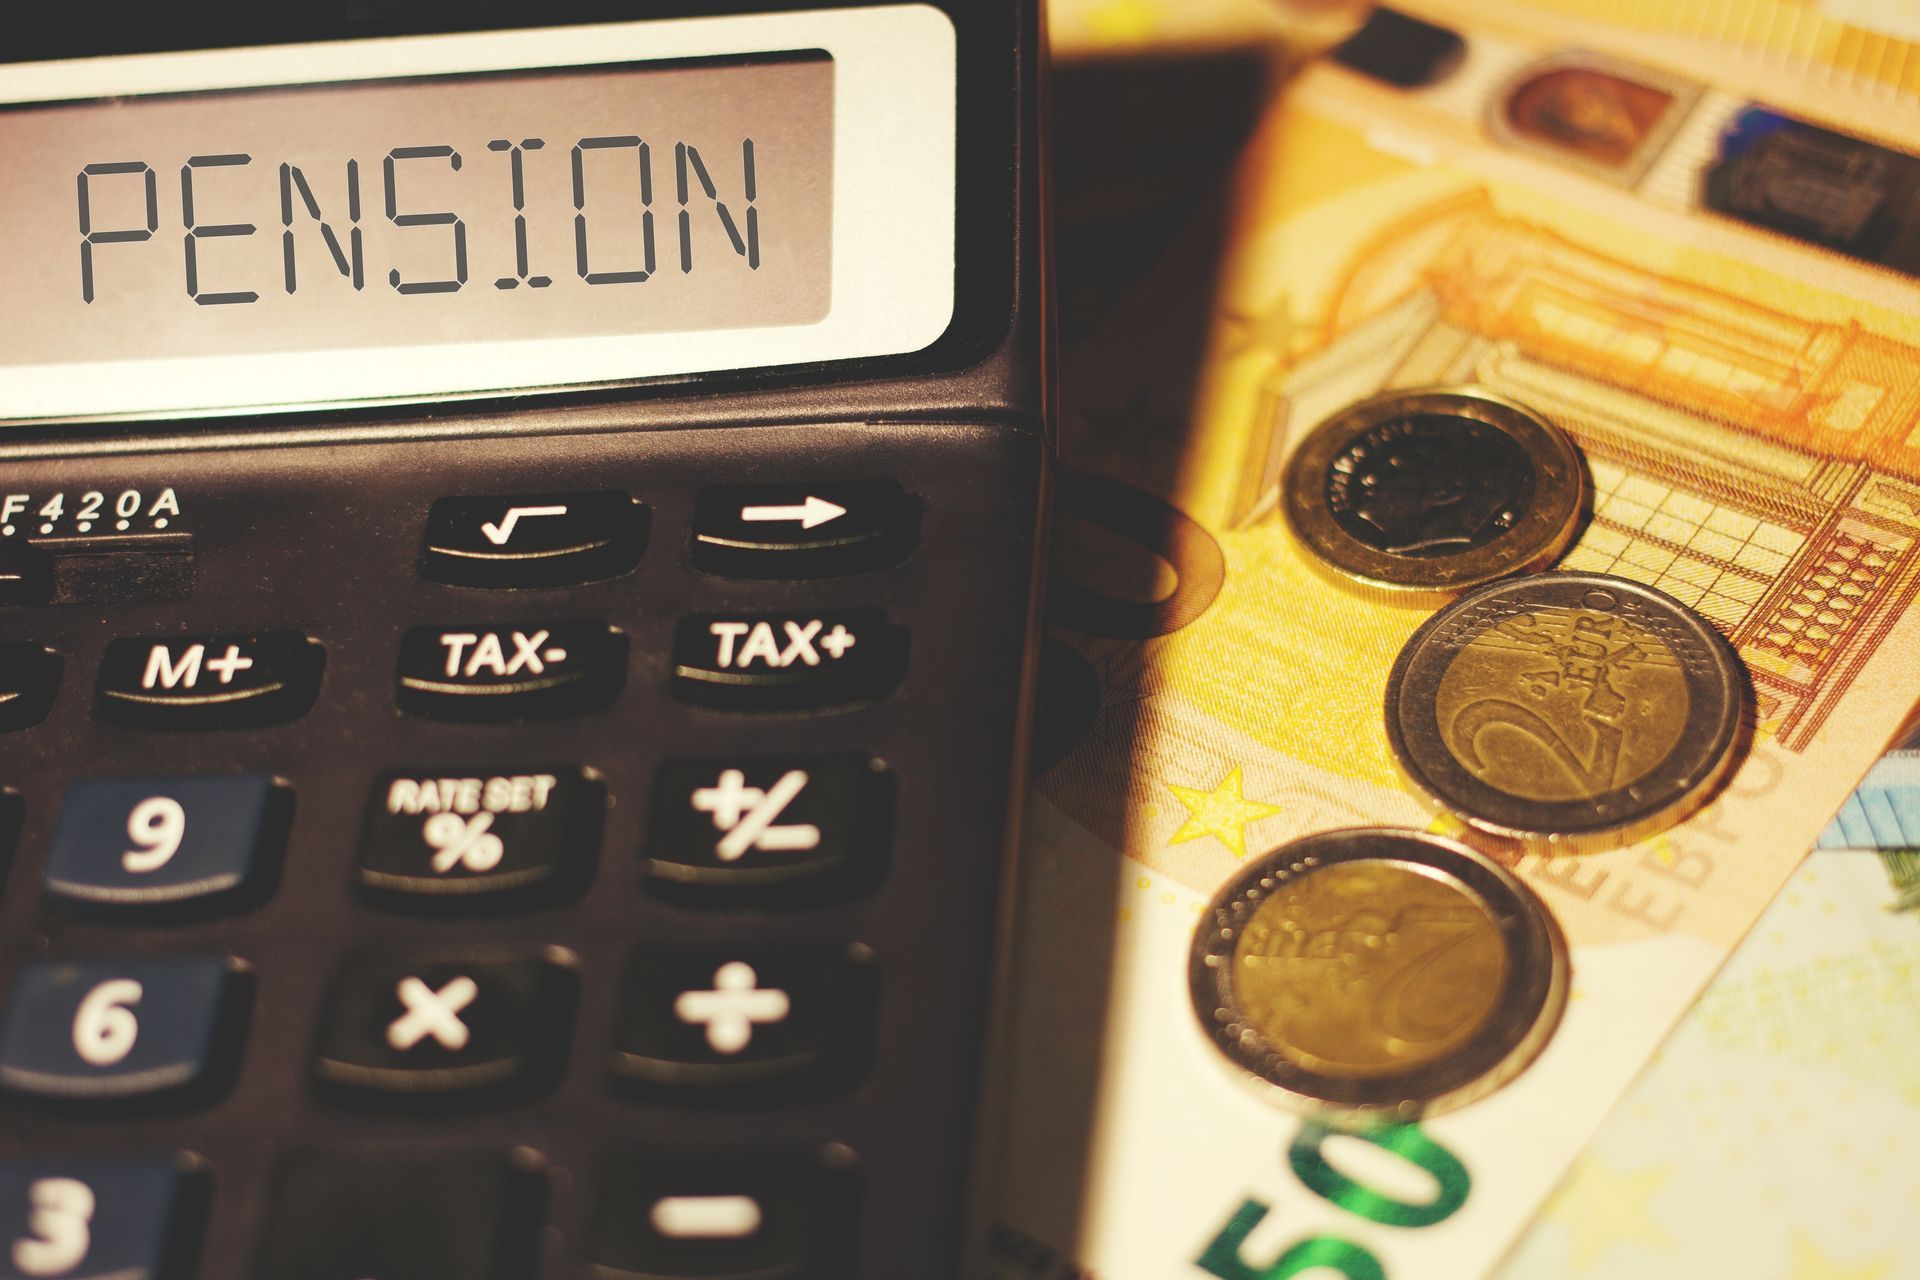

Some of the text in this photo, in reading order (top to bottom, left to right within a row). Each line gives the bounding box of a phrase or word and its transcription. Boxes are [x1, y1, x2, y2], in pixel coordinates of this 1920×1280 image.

[77, 136, 760, 306] PENSION
[142, 644, 253, 688] M+
[440, 630, 567, 677] TAX-
[710, 619, 856, 667] TAX+
[387, 774, 556, 815] RATE SET
[122, 795, 187, 873] 9
[423, 811, 504, 873] %
[72, 978, 143, 1066] 6
[10, 1177, 96, 1276] 3
